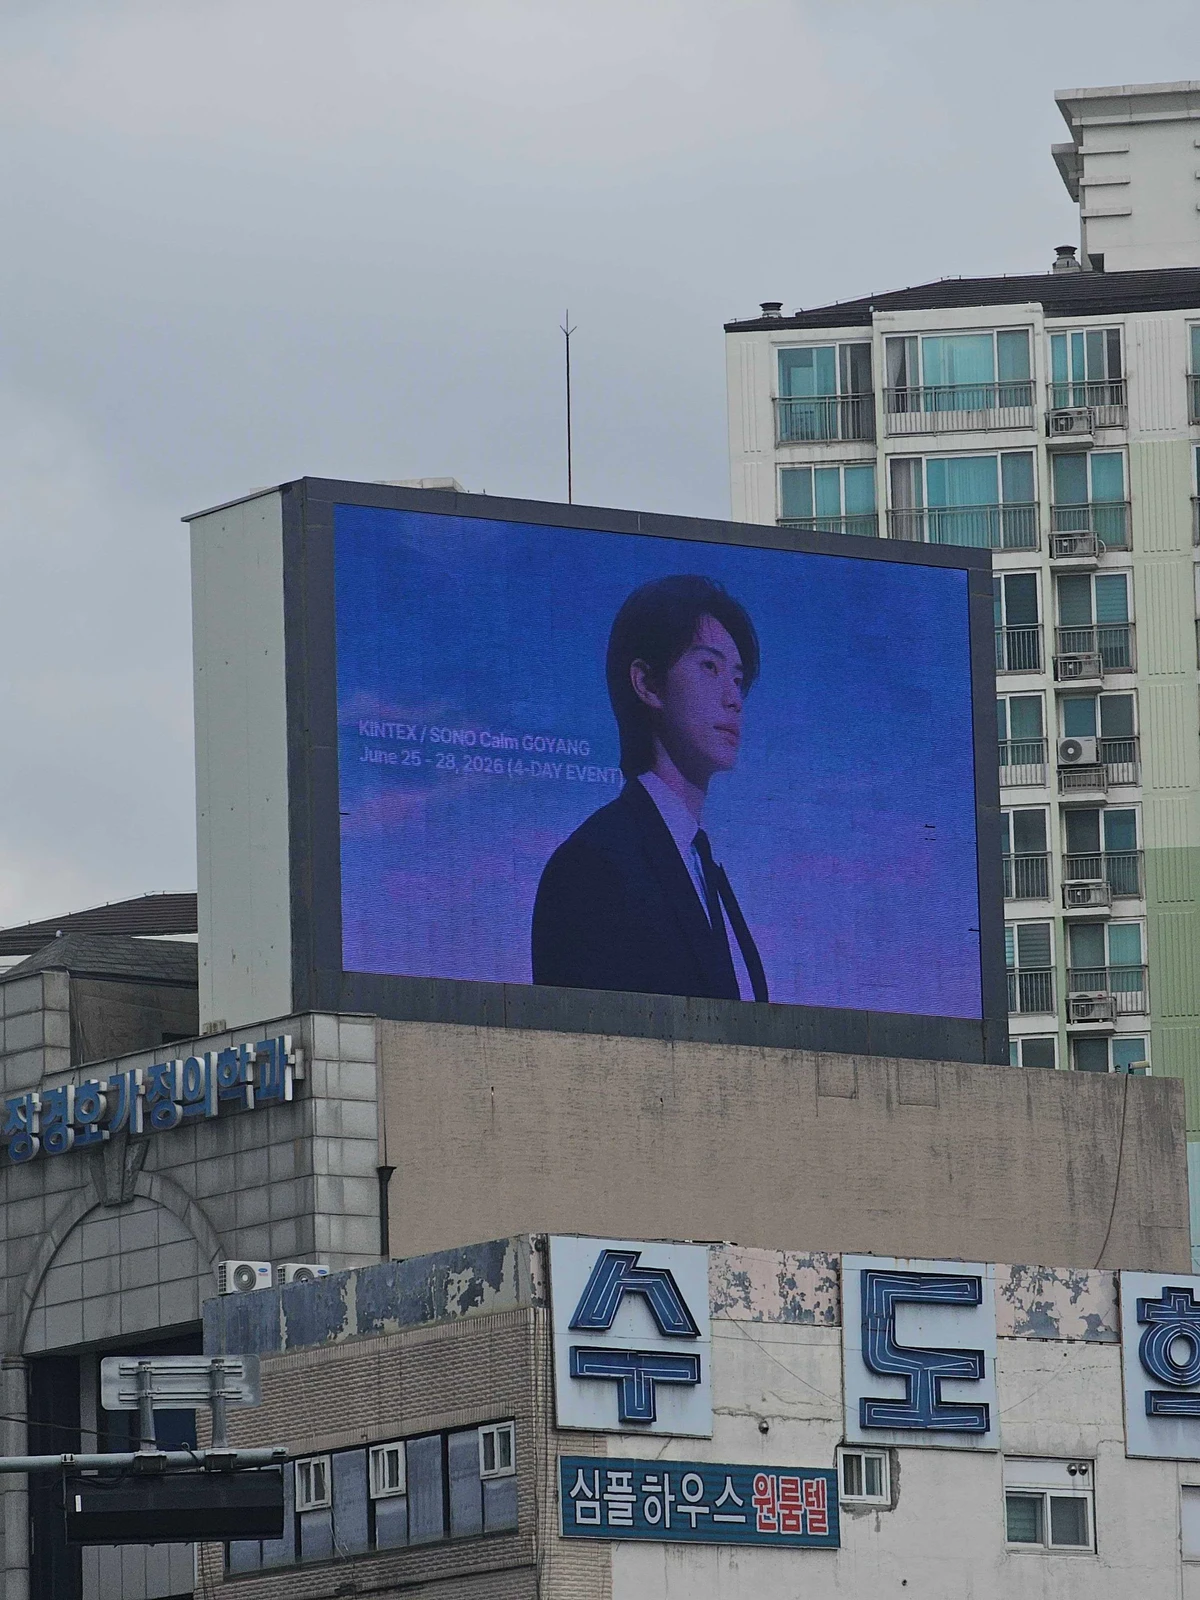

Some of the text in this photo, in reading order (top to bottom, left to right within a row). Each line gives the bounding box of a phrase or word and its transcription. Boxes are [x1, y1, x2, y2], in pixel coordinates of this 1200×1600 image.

[358, 719, 417, 741] KINTEX
[430, 727, 476, 746] SONO
[480, 731, 519, 749] Calm
[522, 735, 591, 756] GOYANG
[359, 746, 398, 765] June
[401, 750, 422, 767] 25
[462, 755, 504, 774] 2026
[569, 1468, 829, 1535] 심플하우스 원룸텔
